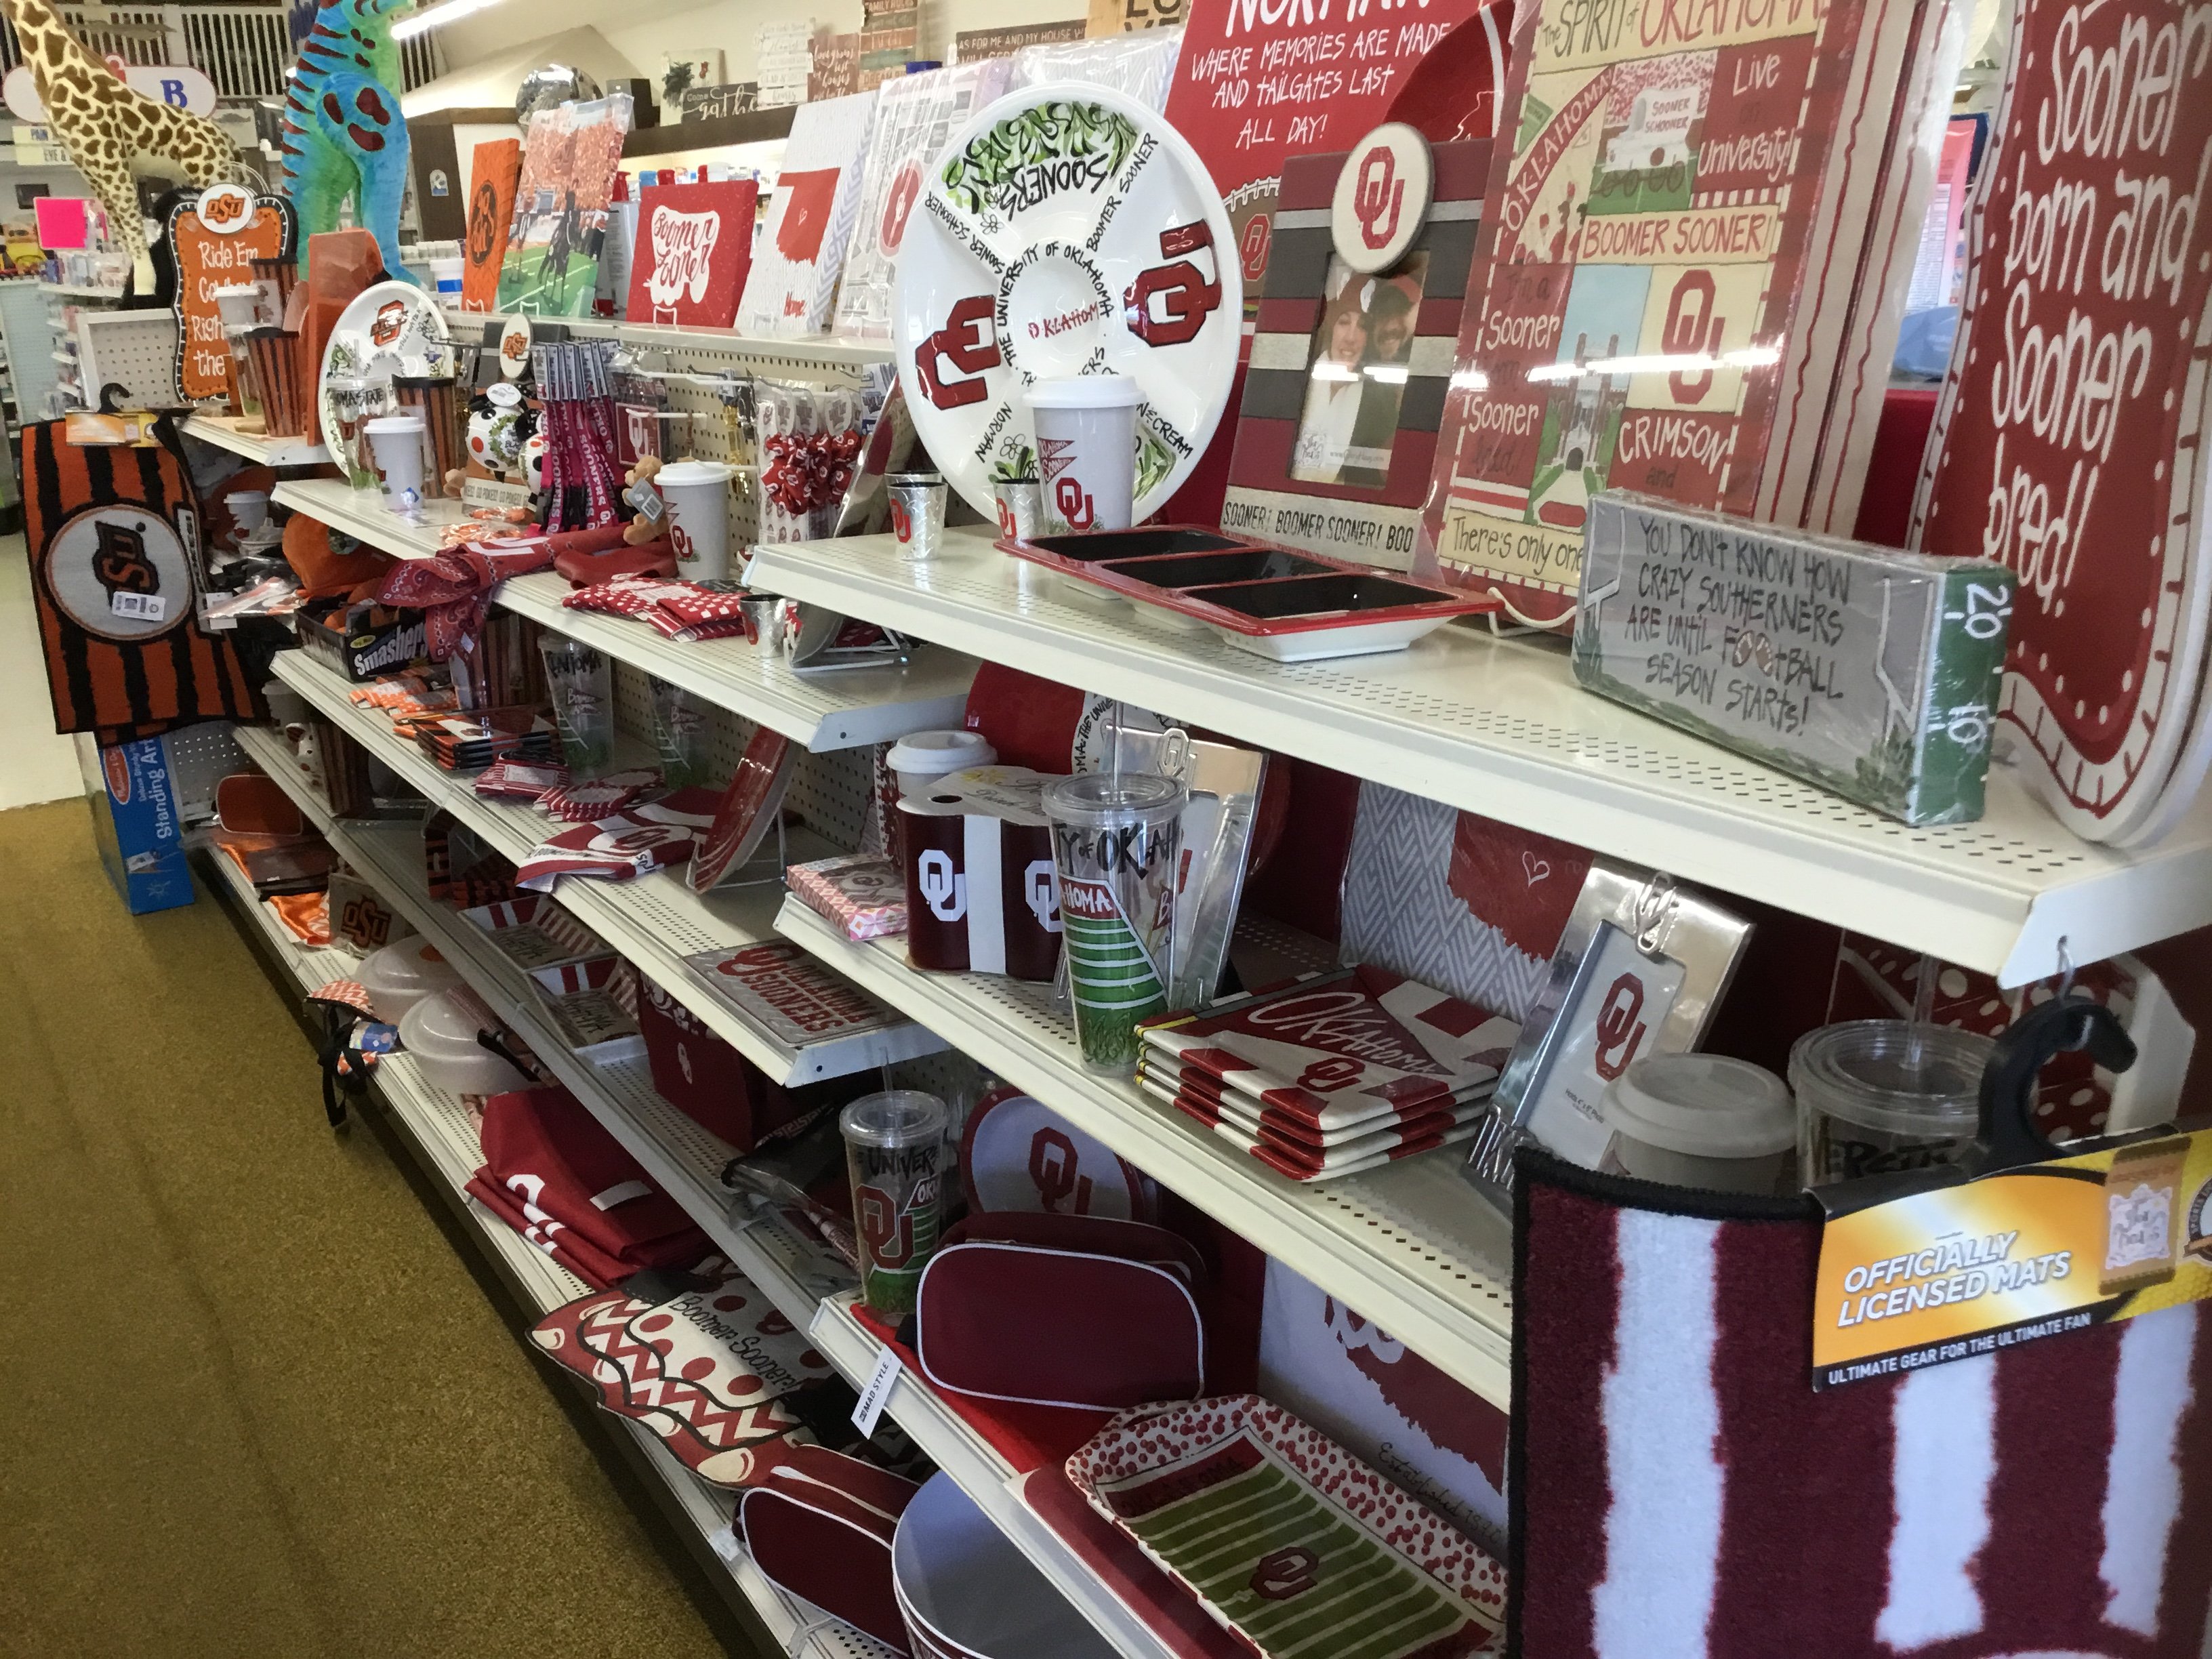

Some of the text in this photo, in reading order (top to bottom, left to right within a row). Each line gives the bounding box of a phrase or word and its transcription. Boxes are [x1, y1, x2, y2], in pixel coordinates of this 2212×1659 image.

[958, 39, 970, 50] AS
[972, 37, 988, 49] FOR
[990, 36, 1002, 47] ME
[1005, 33, 1023, 46] AND
[1041, 28, 1071, 43] HOUSE
[1191, 22, 1452, 83] WHERE MEMORIES ARE MADE
[1542, 23, 1561, 48] The
[1555, 0, 1625, 57] SPIRIT
[161, 79, 188, 109] B
[683, 84, 758, 121] gathe
[1212, 63, 1395, 109] AND TAILGATES LAST
[1732, 52, 1780, 96] Live
[2038, 5, 2212, 165] Sooner
[1235, 114, 1328, 150] ALL DAY!
[1645, 116, 1689, 134] SCHOONER
[1652, 97, 1691, 117] SOONER
[998, 152, 1109, 222] SOONERS
[1120, 131, 1160, 194] SOONER
[205, 193, 246, 224] OSU
[925, 190, 970, 241] SCHOONER
[1086, 194, 1122, 253] BOOMER
[1354, 146, 1406, 251] OU
[2004, 149, 2097, 296] born
[2102, 135, 2212, 308] and
[197, 240, 258, 270] Ride Em
[970, 234, 1006, 274] SOONER
[1045, 240, 1059, 258] OF
[1582, 214, 1774, 259] BOOMER SOONER!
[996, 243, 1040, 327] UNIVERSITY
[1063, 245, 1115, 319] OKLAHOMA
[191, 314, 224, 342] Righ
[998, 332, 1017, 367] THE
[1486, 310, 1561, 351] Sooner
[192, 349, 226, 377] the
[1991, 277, 2152, 464] Sooner
[975, 401, 1013, 464] NORMAN
[1152, 417, 1194, 460] CREAM
[1468, 395, 1540, 436] Sooner
[1618, 414, 1731, 474] CRIMSON
[996, 497, 1017, 541] OU
[1055, 477, 1095, 530] OU
[1223, 501, 1272, 531] SOONER!
[1275, 509, 1324, 539] BOOMER
[1328, 515, 1382, 549] SOONER!
[1982, 432, 2100, 617] bred!
[1453, 516, 1511, 559] There's
[1517, 534, 1553, 575] only
[1638, 515, 1677, 558] YOU
[1736, 541, 1797, 588] KNOW
[1804, 554, 1854, 605] HOW
[1637, 562, 1845, 647] CRAZY SOUTHERNERS
[1625, 605, 1844, 701] ARE UNTIL FOOTBALL
[1645, 653, 1809, 737] SEASON STARTS!
[1078, 714, 1090, 740] THE
[148, 768, 173, 840] Standing
[918, 848, 968, 923] OU
[739, 973, 844, 1032] SOONERS
[781, 964, 886, 1024] OKLAHOMA
[1595, 972, 1647, 1082] OU
[855, 1183, 915, 1269] OU
[1837, 1252, 2071, 1328] LICENSED MATS
[1843, 1229, 2018, 1295] OFFICIALLY
[668, 1295, 804, 1391] Boomer Sooner!
[1828, 1311, 2092, 1385] ULTIMATE GEAR FOR THE ULTIMATE FAN
[863, 1360, 890, 1414] MAD STYLE
